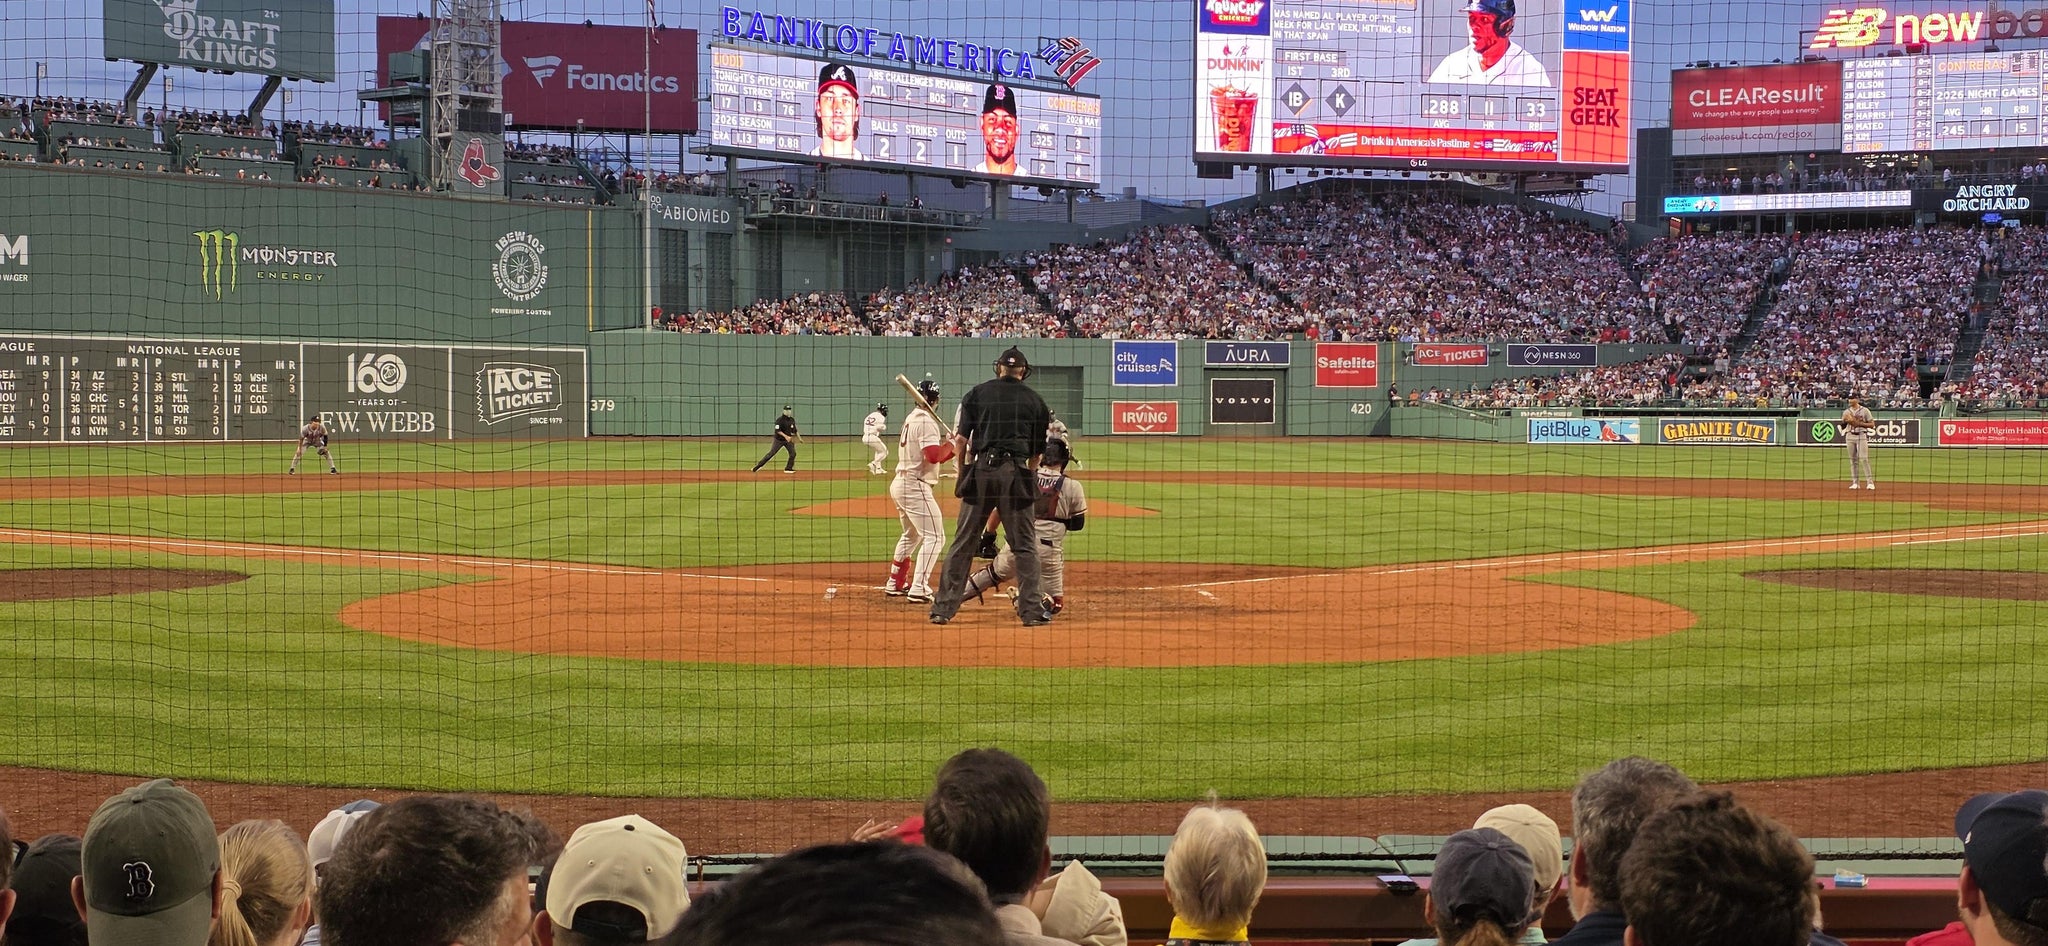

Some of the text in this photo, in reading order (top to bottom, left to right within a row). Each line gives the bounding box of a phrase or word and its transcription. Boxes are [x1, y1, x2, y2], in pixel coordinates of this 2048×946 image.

[264, 9, 280, 19] 21+
[1274, 9, 1397, 24] WAS NAMED PLAYER THE
[163, 10, 280, 46] DRAFT
[1273, 20, 1294, 29] WEEK
[1296, 21, 1312, 30] FOR
[1315, 22, 1335, 31] LAST
[1362, 24, 1393, 34] HITTING
[1895, 11, 1984, 44] new
[723, 5, 1036, 80] BANK OF AMERICA
[1284, 31, 1328, 41] THAT SPAN
[177, 40, 278, 70] KINGS
[1284, 51, 1338, 63] FIRST BASE
[1207, 57, 1264, 72] DUNKIN'
[1938, 59, 2007, 71] CONTRERAS
[567, 64, 679, 94] Fanatics
[1331, 67, 1351, 78] 3RD
[758, 75, 780, 88] PITCH
[783, 78, 810, 91] COUNT
[868, 69, 974, 93] ABS CHALLENGES REMAINING
[1856, 80, 1885, 89] OLSON
[715, 82, 795, 101] TOTAL STRIKES PCT
[871, 85, 946, 104] ATL BOS
[1573, 86, 1619, 107] SEAT
[1689, 83, 1824, 107] CLEAResult
[1936, 87, 2038, 100] 2026 NIGHT GAMES
[1335, 93, 1346, 109] K
[782, 104, 795, 116] 76
[1424, 99, 1546, 118] .288 33
[1705, 108, 1780, 119] change the way people
[1944, 104, 2029, 116] AVG HR RBI
[714, 114, 773, 129] 2026 SEASON
[1570, 107, 1620, 128] GEEK
[871, 120, 967, 141] BALLS STRIKES OUTS
[1938, 122, 2028, 136] .245 15
[1361, 135, 1387, 146] Drink
[1395, 137, 1436, 148] America's
[1437, 138, 1470, 149] Pastime
[1700, 130, 1813, 142] clearesult.com/redsox
[879, 137, 926, 161] 2 2
[1955, 184, 2018, 198] ANGRY
[1943, 197, 2030, 212] ORCHARD
[663, 208, 730, 224] ABIOMED
[494, 231, 546, 255] IBEW 103
[3, 273, 29, 282] WAGER
[257, 271, 325, 282] ENERGY
[491, 263, 504, 290] NECA
[502, 265, 549, 302] CONTRACTORS
[128, 345, 241, 356] NATIONAL LEAGUE
[1116, 351, 1138, 363] city
[1419, 349, 1486, 362] ACE TICKET
[1542, 352, 1581, 360] NESN 360
[1116, 362, 1157, 374] cruises
[1317, 356, 1376, 369] Safelite
[70, 371, 105, 380] 34 AZ
[171, 373, 189, 382] STL
[233, 373, 268, 383] 50 WSH
[347, 352, 407, 394] 160
[70, 382, 105, 391] 72 SF
[154, 383, 189, 392] 39 MIL
[493, 367, 553, 395] ACE
[233, 384, 268, 393] 32 CLE
[70, 393, 109, 403] 50 CHC
[154, 394, 188, 403] 39 MIA
[233, 394, 268, 404] 11 COL
[358, 398, 385, 406] YEARS
[495, 391, 553, 411] TICKET
[70, 404, 107, 414] 36 PIT
[154, 405, 189, 414] 34 TOR
[233, 405, 268, 414] 17 LAD
[590, 399, 615, 412] 379
[1350, 403, 1372, 415] 420
[70, 416, 107, 425] 41 CIN
[154, 416, 163, 425] 61
[319, 411, 436, 434] F.W. WEBB
[530, 417, 548, 425] SINCE
[1122, 411, 1168, 424] IRVING
[70, 427, 108, 436] 43 NYM
[154, 426, 187, 436] 10 SD
[1535, 421, 1591, 441] jetBlue
[1837, 420, 1906, 437] wsabi
[1958, 426, 2042, 435] Harvard Pilgrim Health
[122, 861, 155, 899] B
